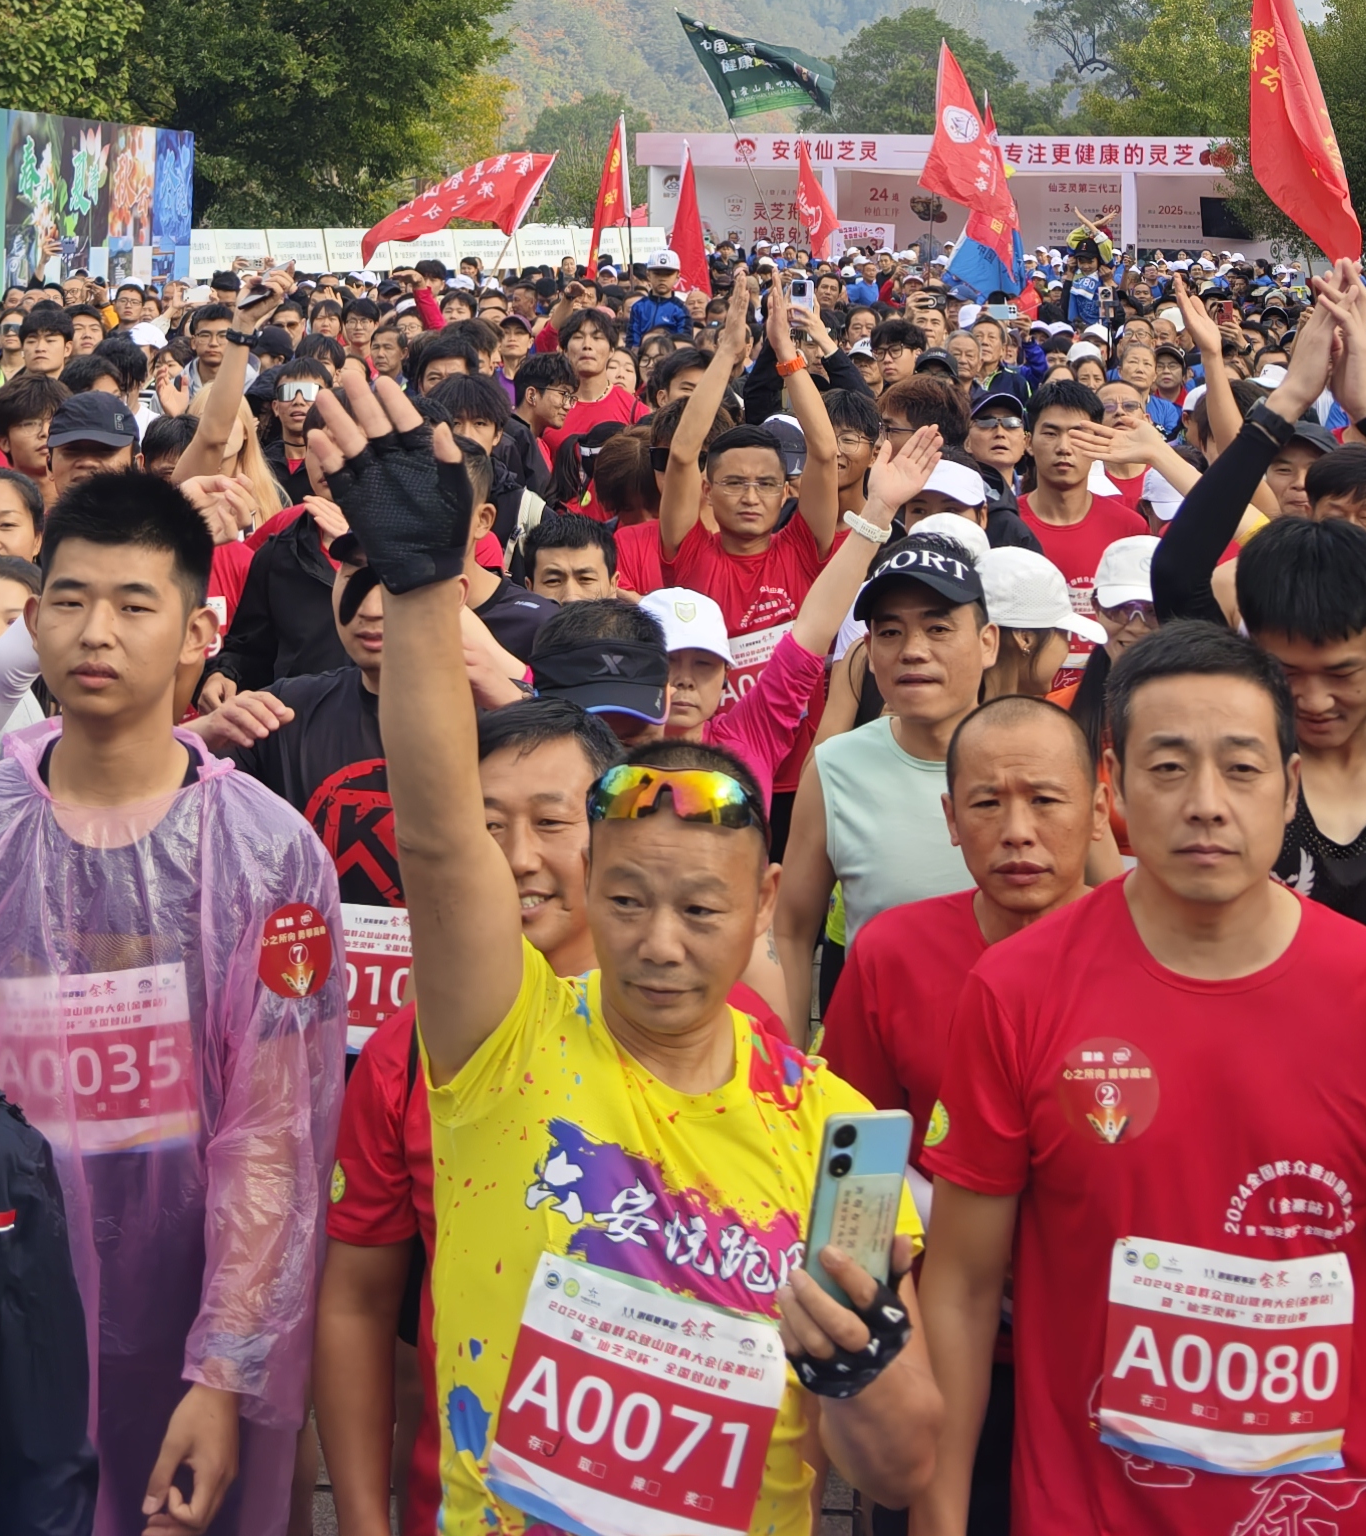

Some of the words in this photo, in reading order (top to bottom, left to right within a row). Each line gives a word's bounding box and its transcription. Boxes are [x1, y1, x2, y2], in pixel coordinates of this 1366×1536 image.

[1004, 142, 1194, 165] 专注更健康的灵芝
[870, 187, 888, 202] 24
[1158, 205, 1183, 215] 2025
[872, 549, 969, 581] PORT
[261, 932, 297, 946] 心之所向
[291, 945, 304, 963] 7
[89, 980, 117, 997] 金寨
[1062, 1068, 1105, 1080] 心之所向
[1100, 1085, 1115, 1105] 2
[1259, 1270, 1290, 1289] 金寨
[1252, 1311, 1308, 1324] 全国登山赛
[680, 1317, 716, 1341] 金寨
[1112, 1324, 1340, 1404] A0080
[664, 1362, 731, 1392] 全国登山赛
[507, 1355, 750, 1489] A0071
